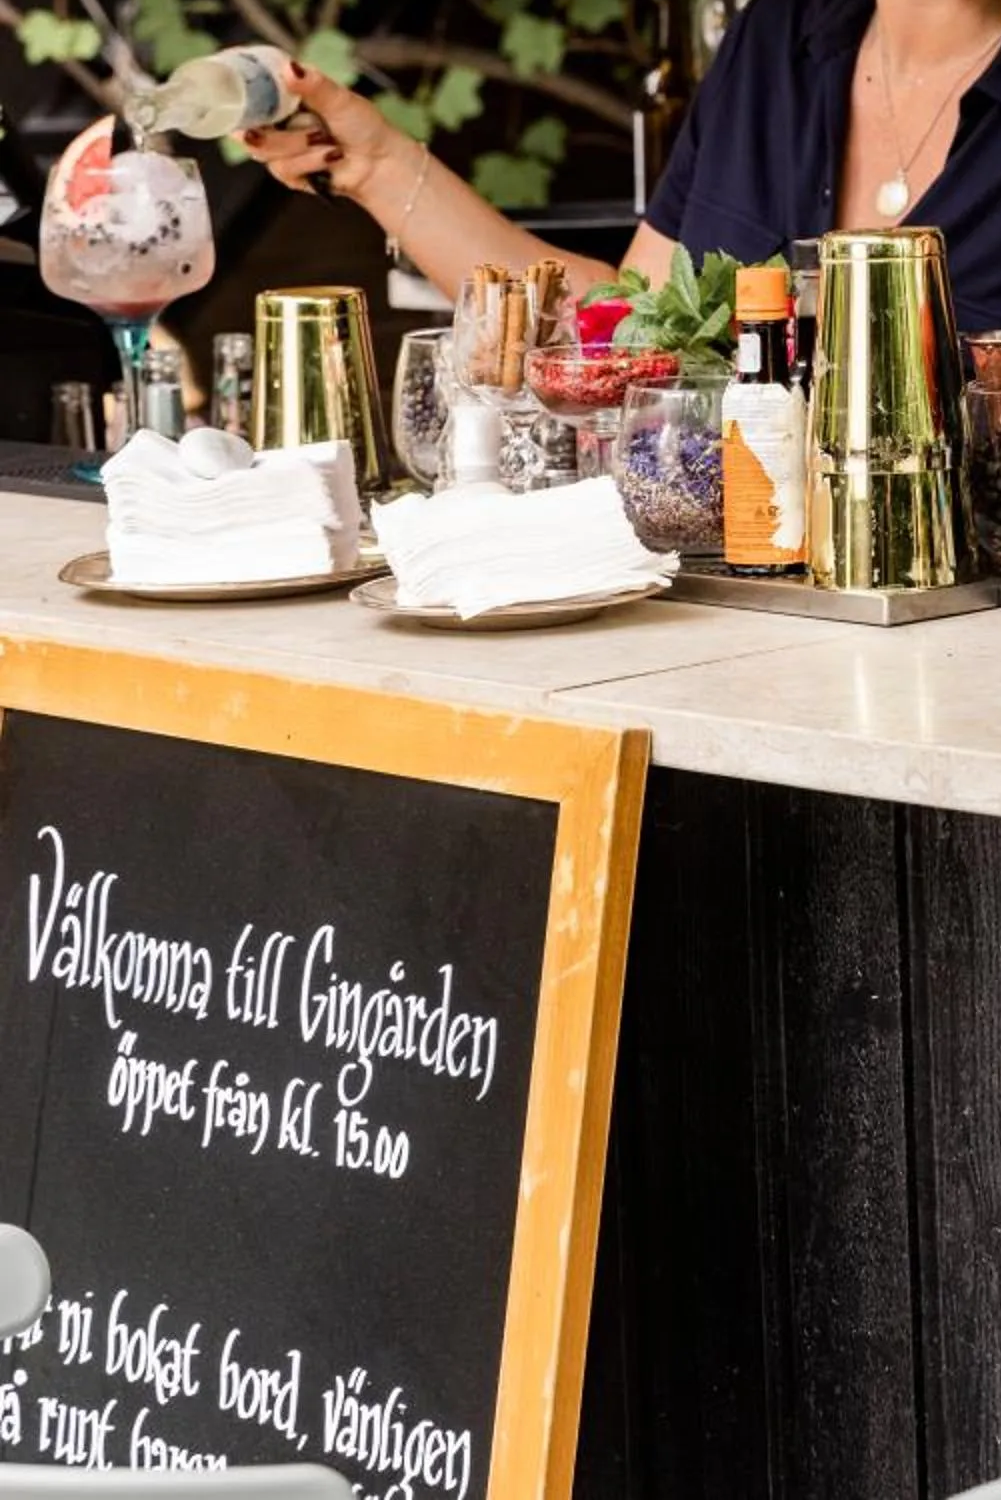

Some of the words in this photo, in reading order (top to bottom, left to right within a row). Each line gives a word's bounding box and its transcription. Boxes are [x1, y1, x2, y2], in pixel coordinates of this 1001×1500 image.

[27, 825, 213, 1029] Välkomna
[225, 923, 297, 1029] till
[300, 924, 498, 1107] Gingården
[107, 1030, 198, 1137] öppet
[202, 1059, 271, 1156] från
[277, 1077, 323, 1157] kl.
[333, 1108, 410, 1179] 15.00
[37, 1398, 118, 1472] runt
[58, 1290, 95, 1366] ni
[105, 1289, 201, 1406] bokat
[219, 1328, 309, 1452] bord,
[322, 1366, 472, 1500] vänligen
